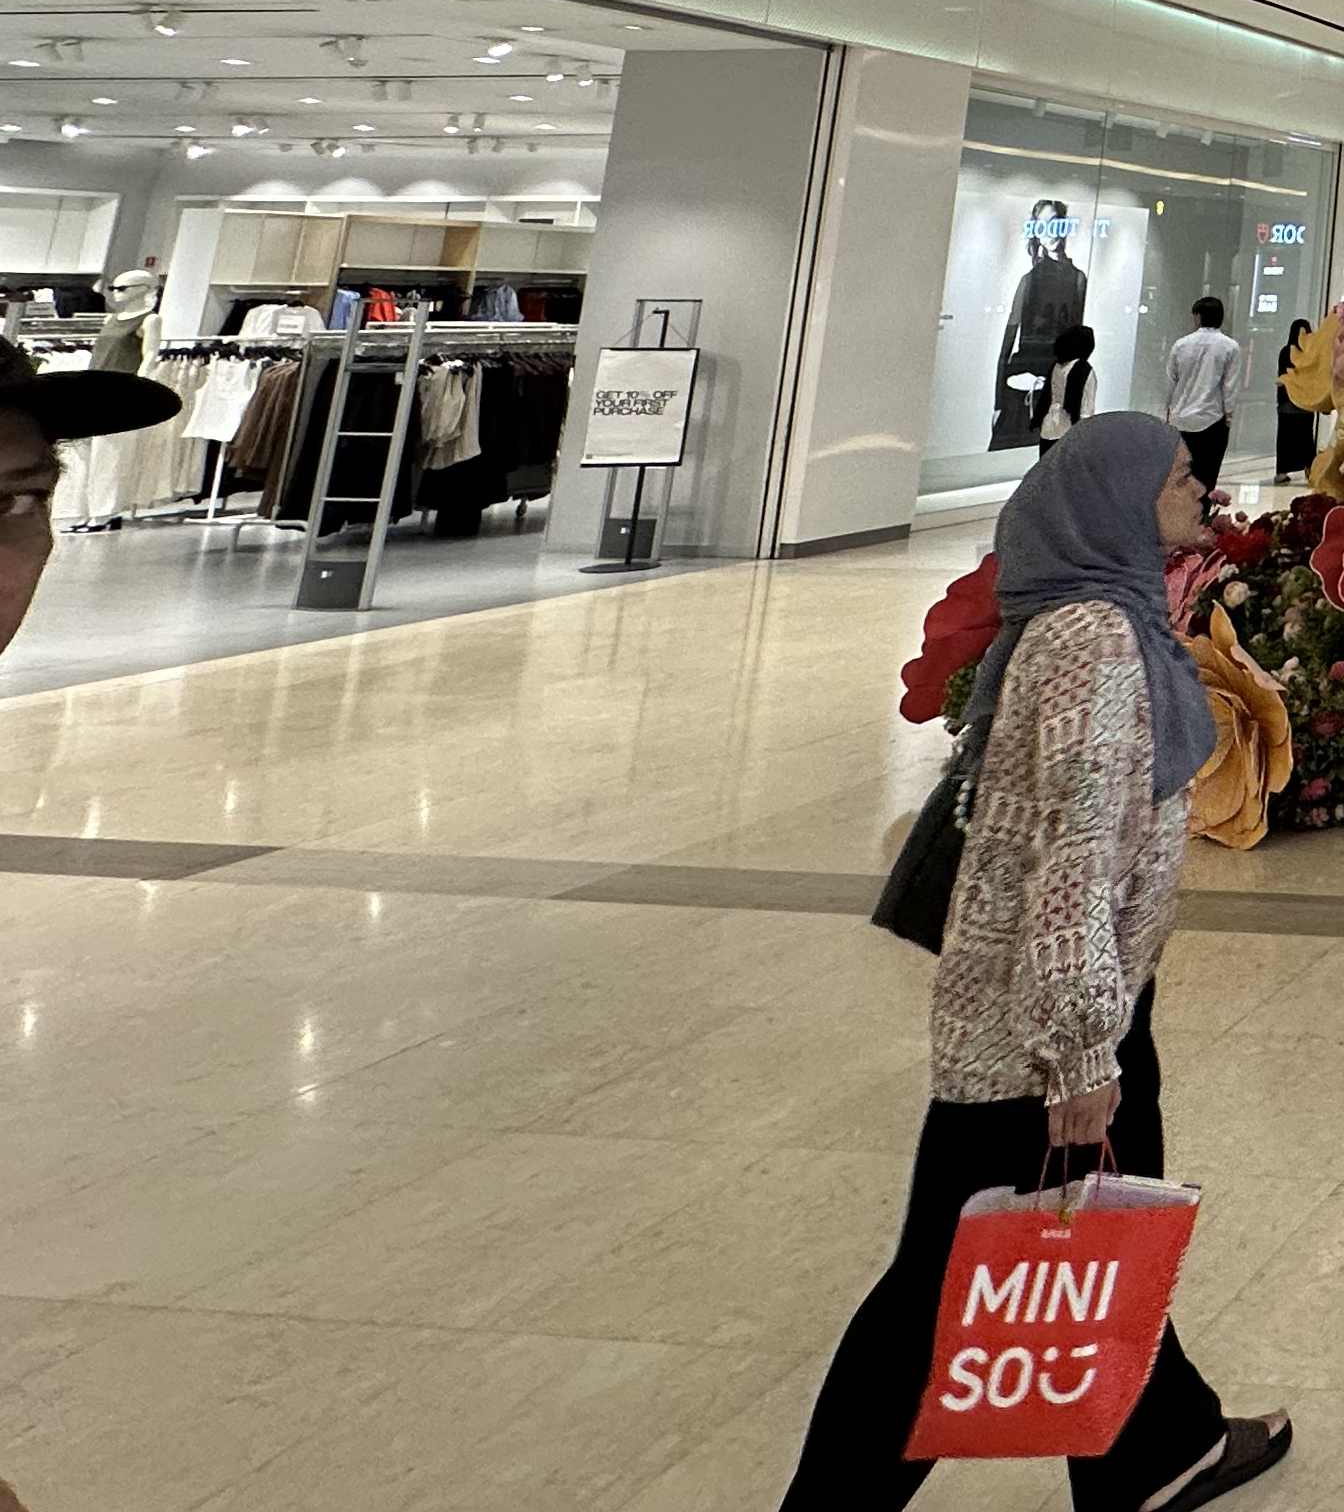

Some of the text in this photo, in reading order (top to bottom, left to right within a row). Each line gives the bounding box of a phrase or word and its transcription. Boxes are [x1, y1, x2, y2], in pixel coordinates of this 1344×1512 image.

[596, 390, 623, 399] GET
[652, 390, 678, 399] OFF
[595, 399, 670, 408] YOUR FIRST
[593, 407, 664, 416] PURCHASE
[961, 1259, 1120, 1327] MINI
